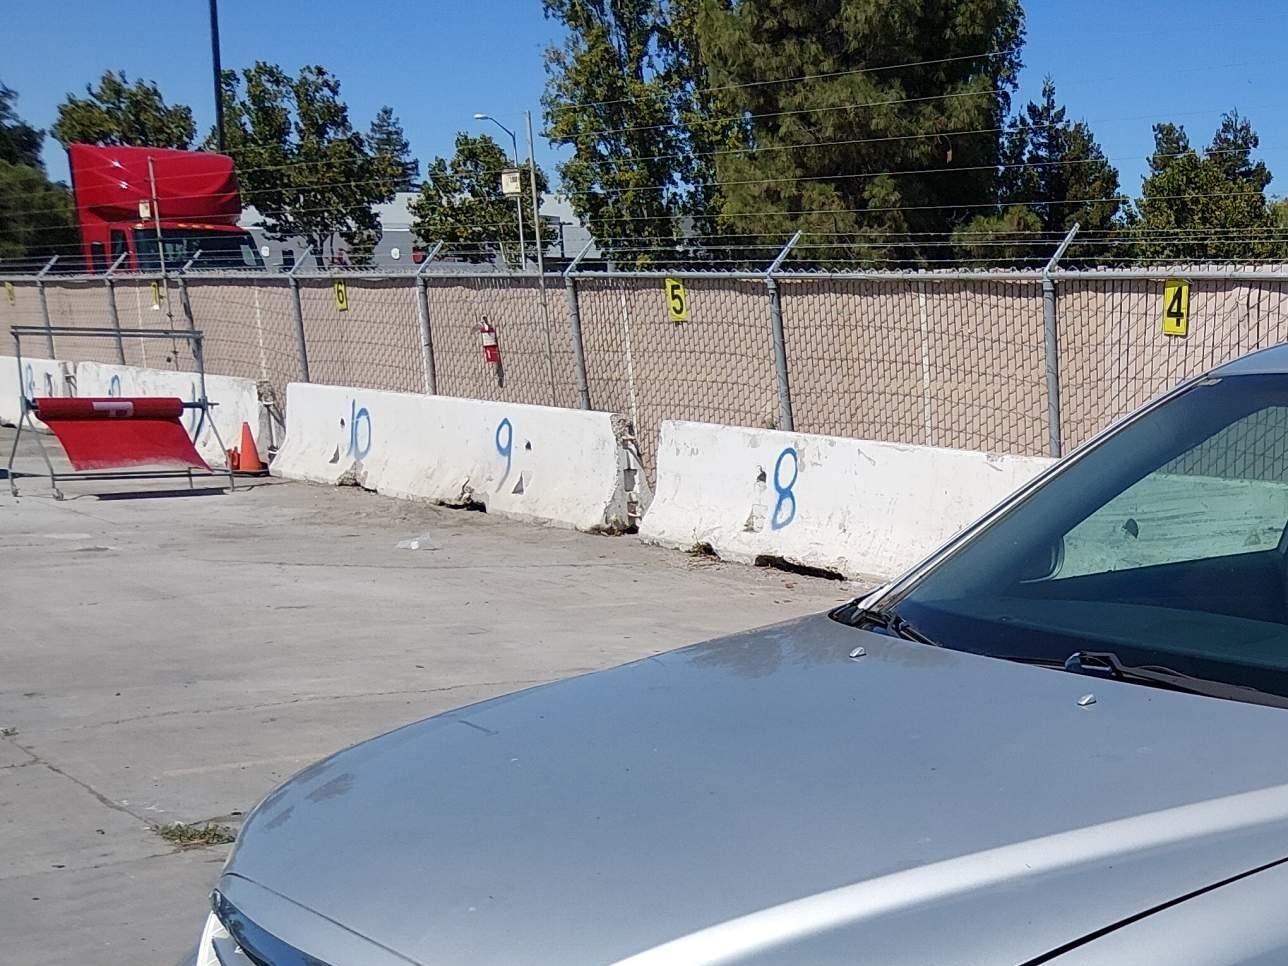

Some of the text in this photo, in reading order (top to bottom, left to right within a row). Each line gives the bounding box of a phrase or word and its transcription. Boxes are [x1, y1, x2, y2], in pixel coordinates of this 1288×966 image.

[337, 281, 344, 304] 6
[670, 284, 684, 315] 5
[1166, 286, 1184, 327] 4
[347, 399, 371, 460] 10
[496, 417, 513, 493] 9
[771, 447, 798, 531] 8
